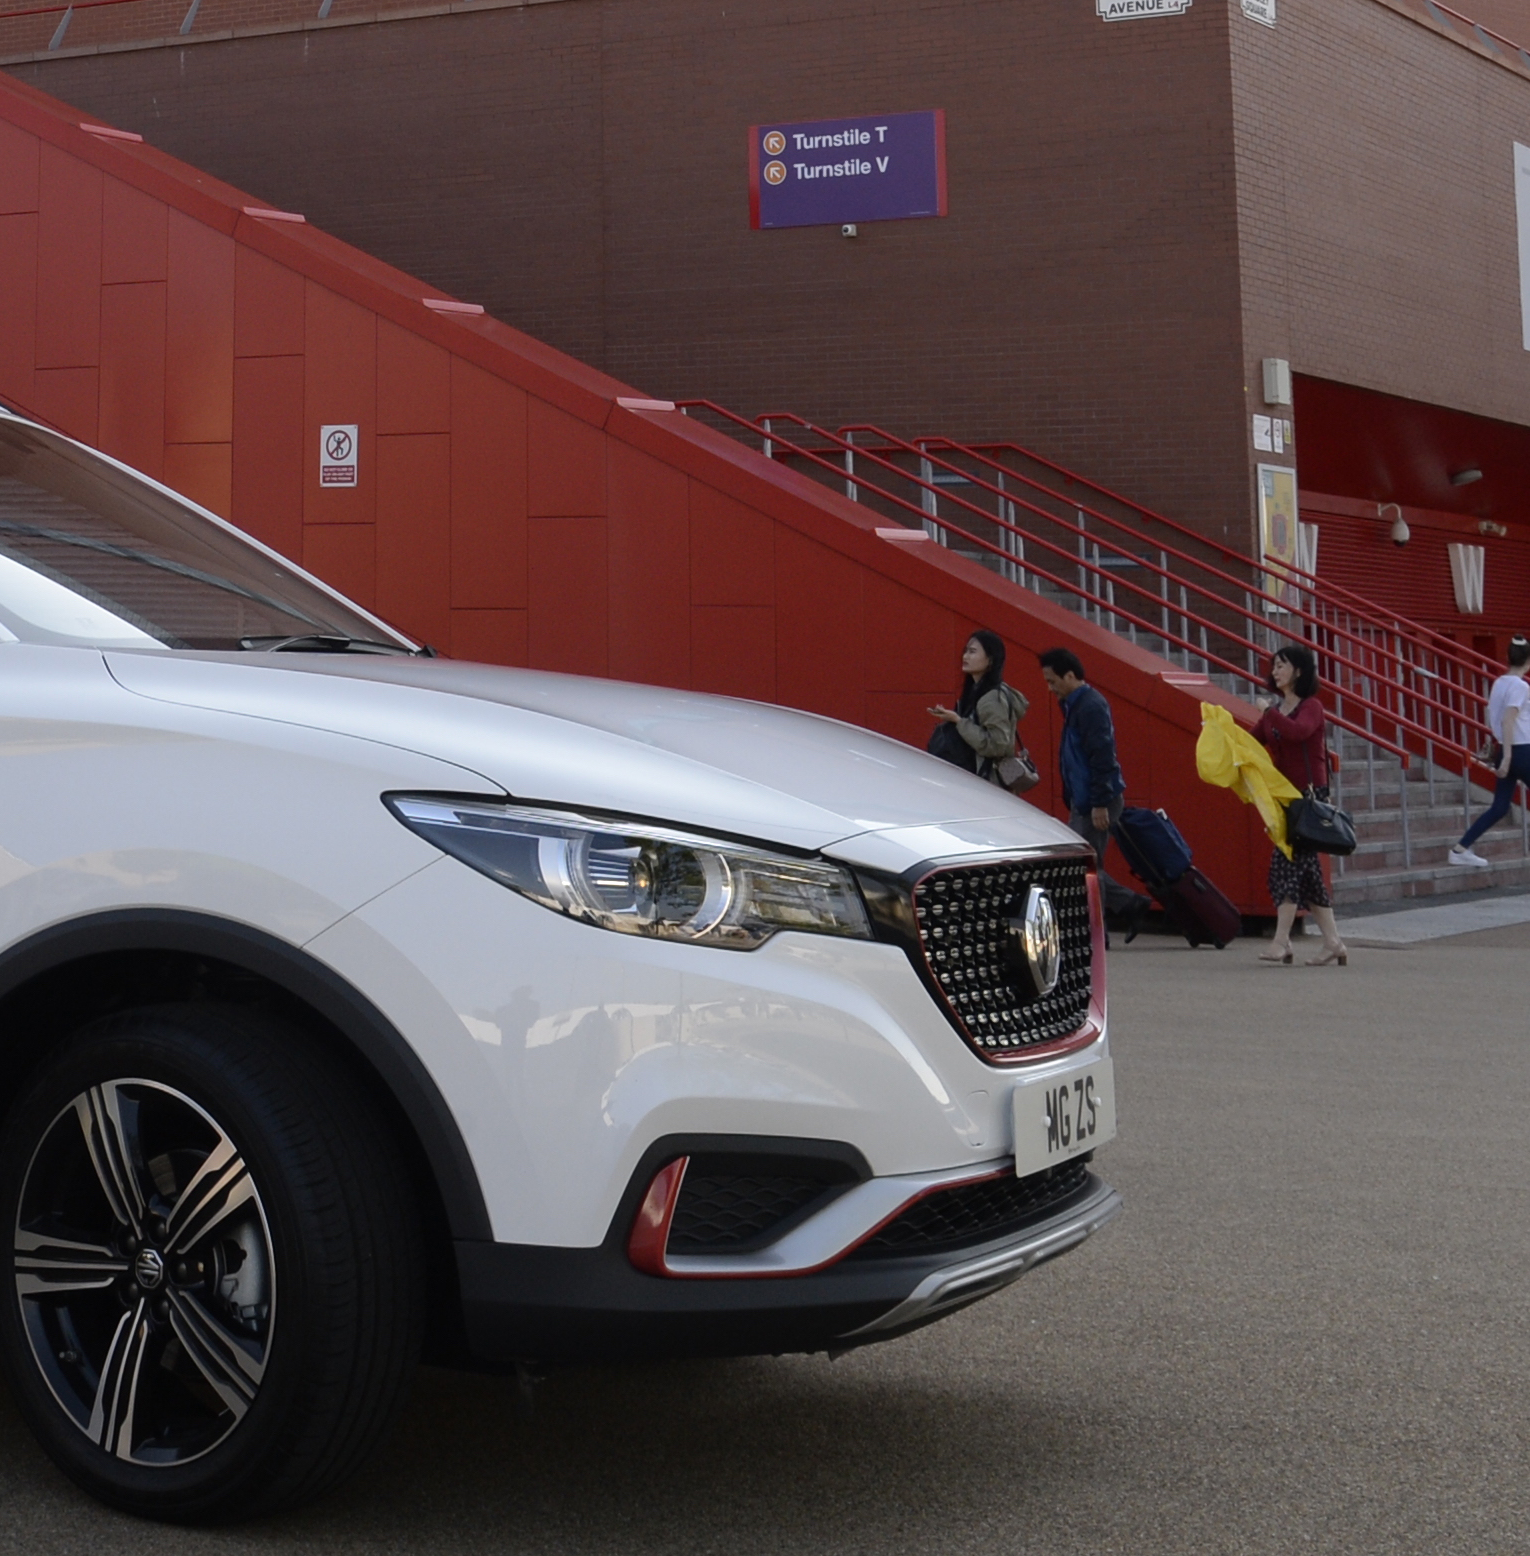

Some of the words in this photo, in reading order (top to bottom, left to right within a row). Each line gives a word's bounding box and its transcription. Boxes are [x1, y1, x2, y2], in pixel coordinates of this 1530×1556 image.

[793, 128, 871, 150] Turnstile
[875, 126, 888, 143] T
[793, 158, 871, 180] Turnstile
[875, 156, 889, 173] V
[1447, 543, 1485, 614] W
[1046, 1085, 1070, 1154] MG
[1074, 1075, 1096, 1142] ZS
